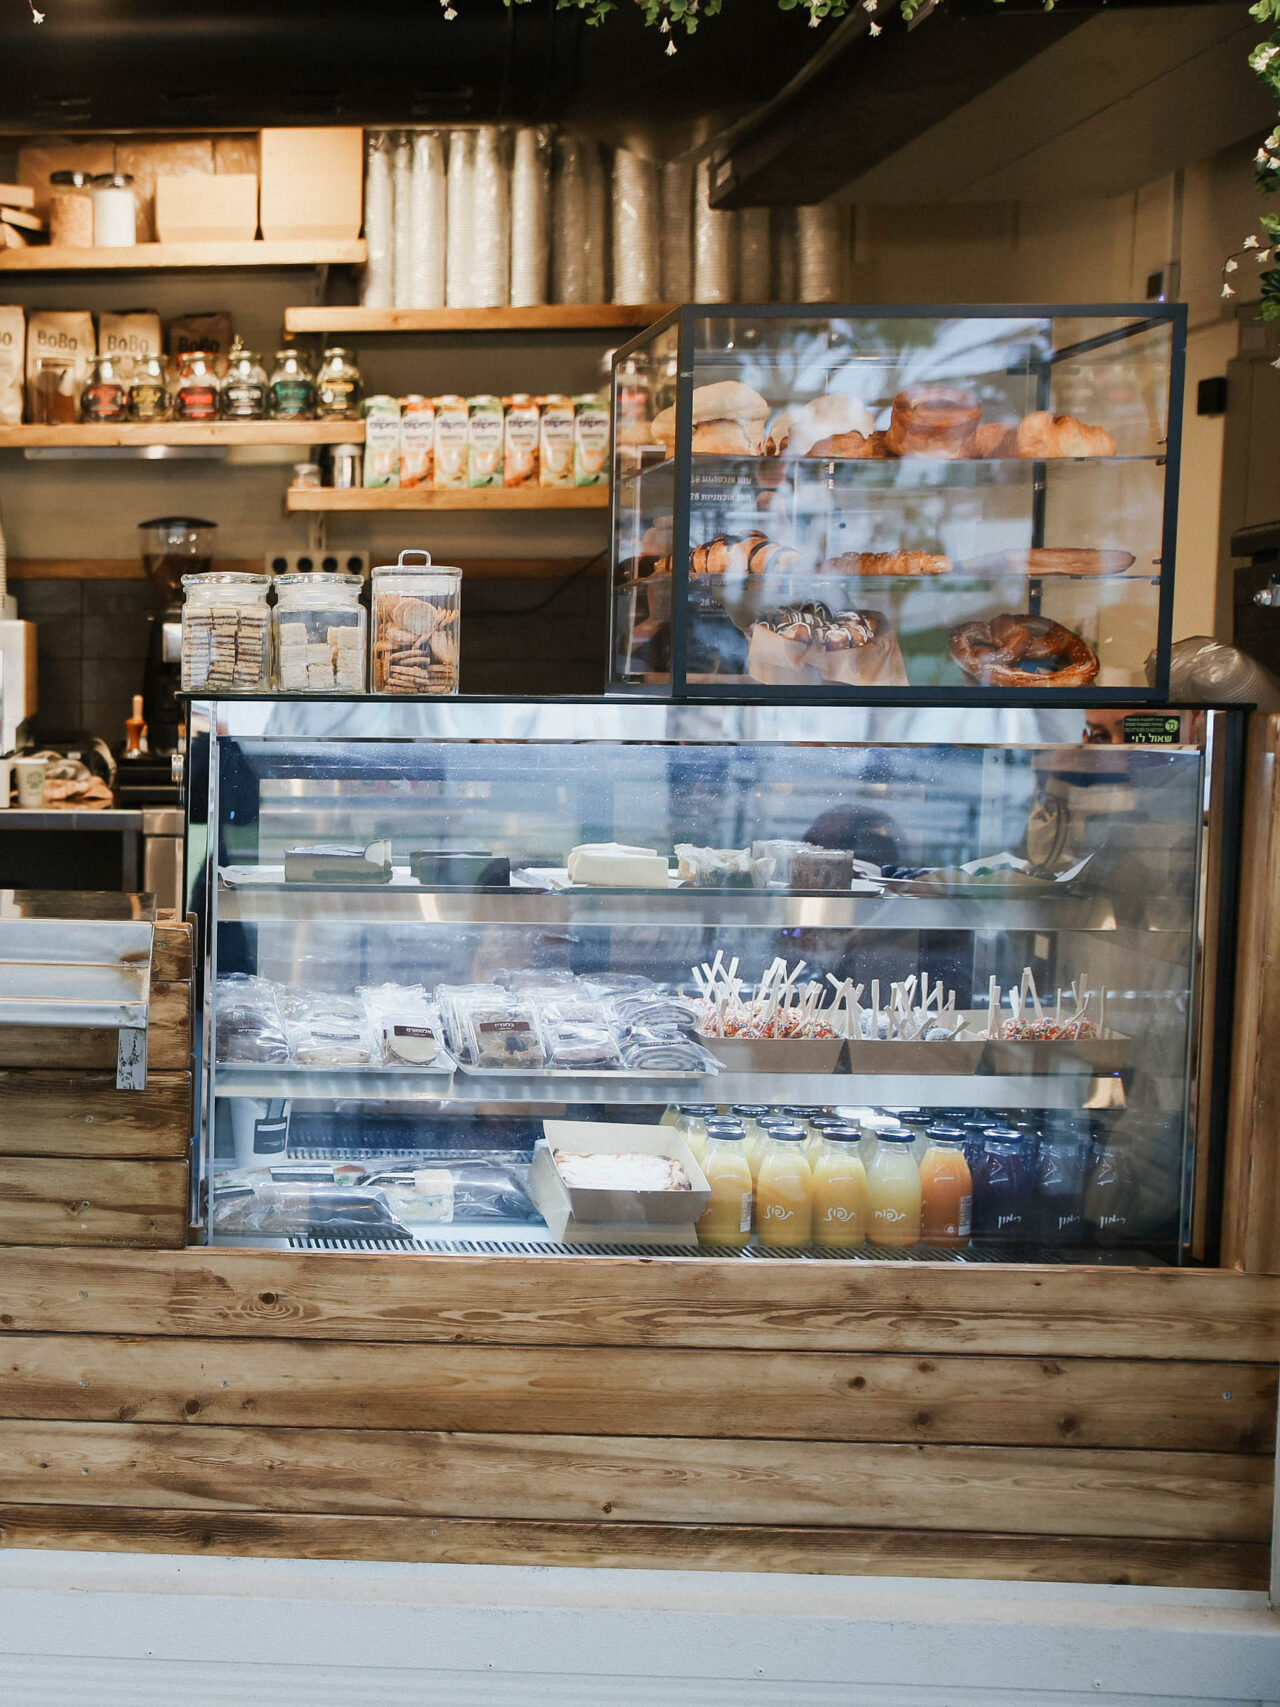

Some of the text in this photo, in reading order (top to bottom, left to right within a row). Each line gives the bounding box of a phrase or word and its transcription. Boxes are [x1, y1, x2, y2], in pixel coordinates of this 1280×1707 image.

[37, 330, 78, 351] BoBo
[107, 334, 150, 353] BoBo
[1131, 733, 1172, 743] שאול לוי
[764, 1205, 794, 1220] תפוז
[823, 1207, 856, 1222] תפוז
[875, 1208, 907, 1222] תפוח
[998, 1213, 1022, 1229] רימון
[1100, 1214, 1127, 1230] רימון
